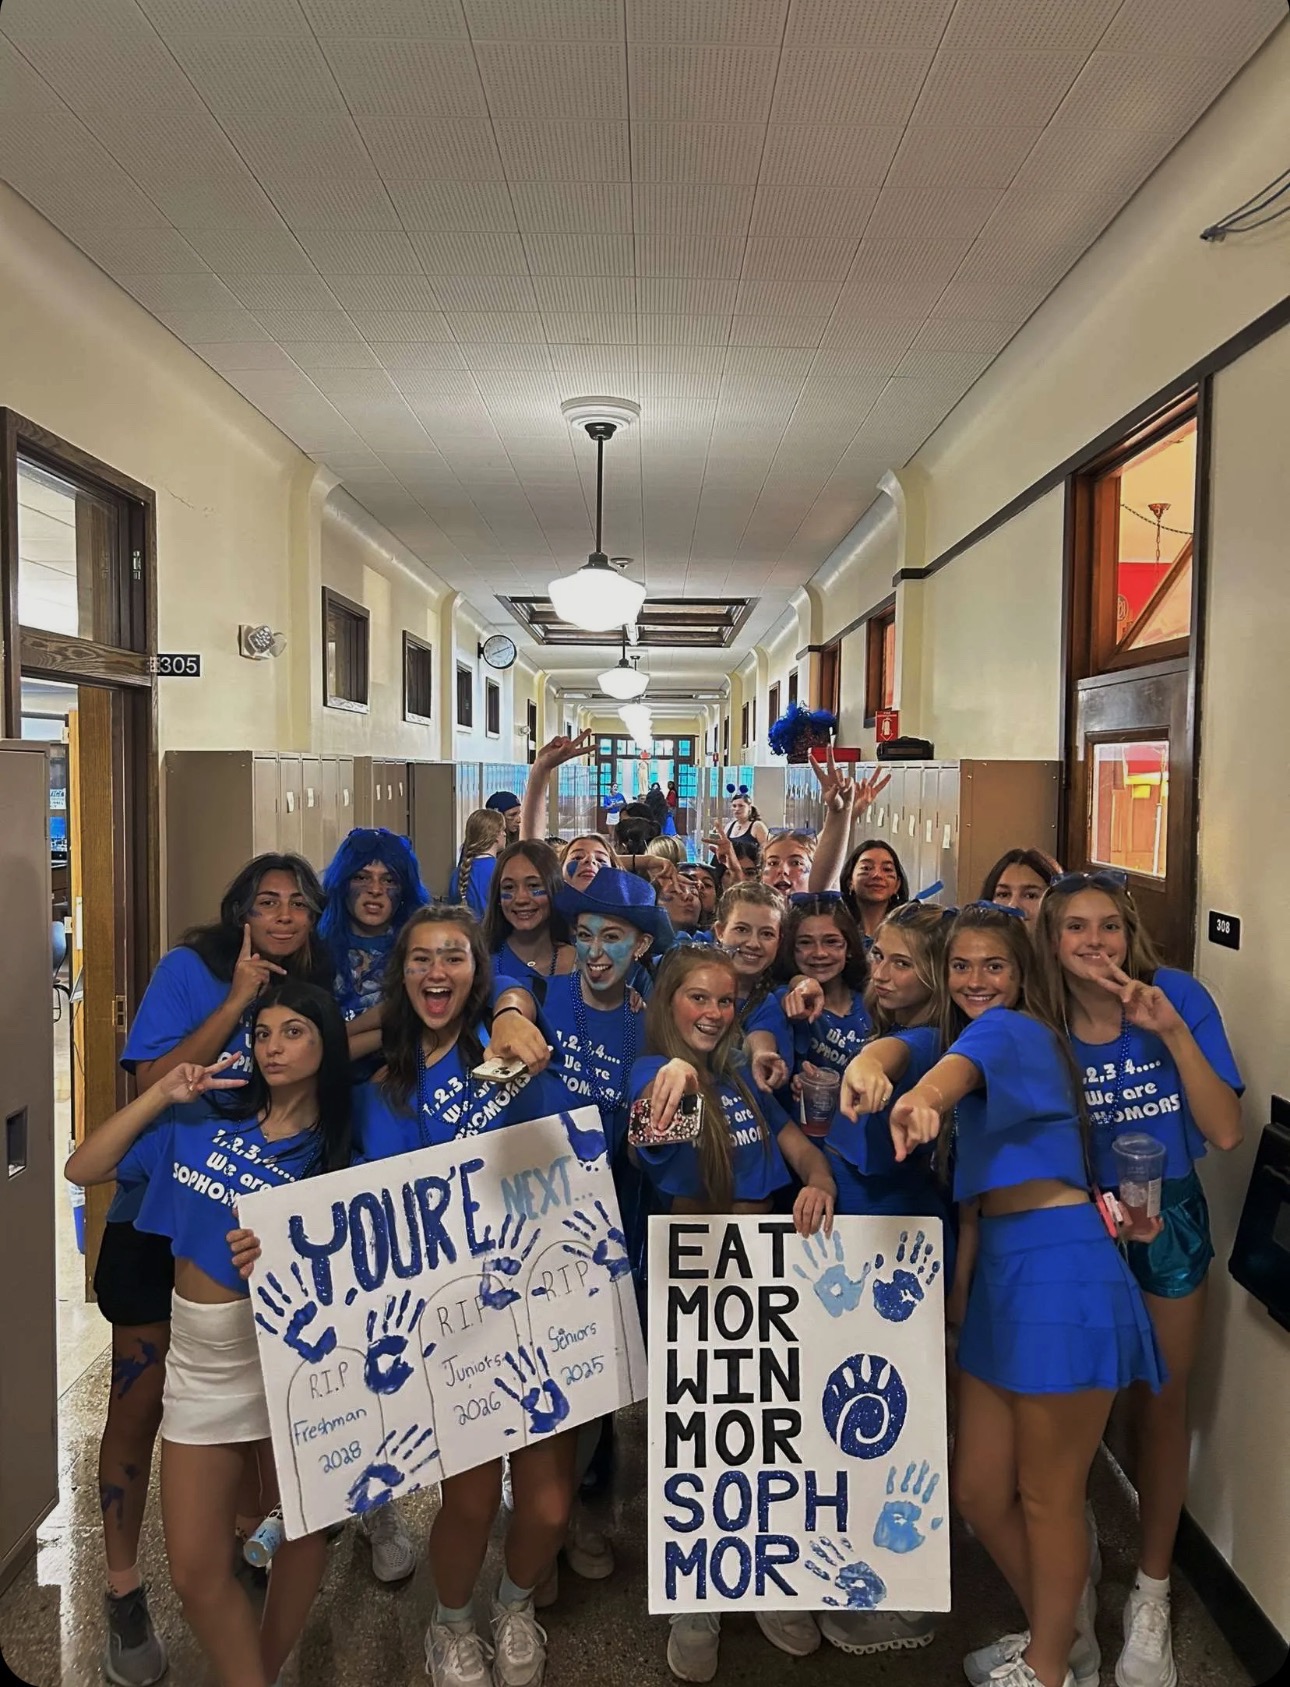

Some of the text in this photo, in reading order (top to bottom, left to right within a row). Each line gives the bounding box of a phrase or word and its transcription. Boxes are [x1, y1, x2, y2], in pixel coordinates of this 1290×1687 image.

[160, 656, 198, 674] 305
[1216, 918, 1231, 934] 308
[1122, 1082, 1158, 1100] are
[734, 1108, 754, 1123] are
[172, 1161, 241, 1209] SOPHOM
[668, 1222, 799, 1279] EAT
[666, 1285, 801, 1343] MOR
[547, 1321, 598, 1353] Seniors
[442, 1353, 502, 1388] Juniors
[560, 1355, 605, 1386] 2025
[666, 1347, 802, 1405] WIN
[453, 1390, 502, 1426] 2026
[293, 1407, 368, 1446] Freshman
[664, 1408, 803, 1469] MOR
[317, 1439, 362, 1474] 2028
[663, 1469, 848, 1534] SOPH
[664, 1534, 801, 1601] MOR
